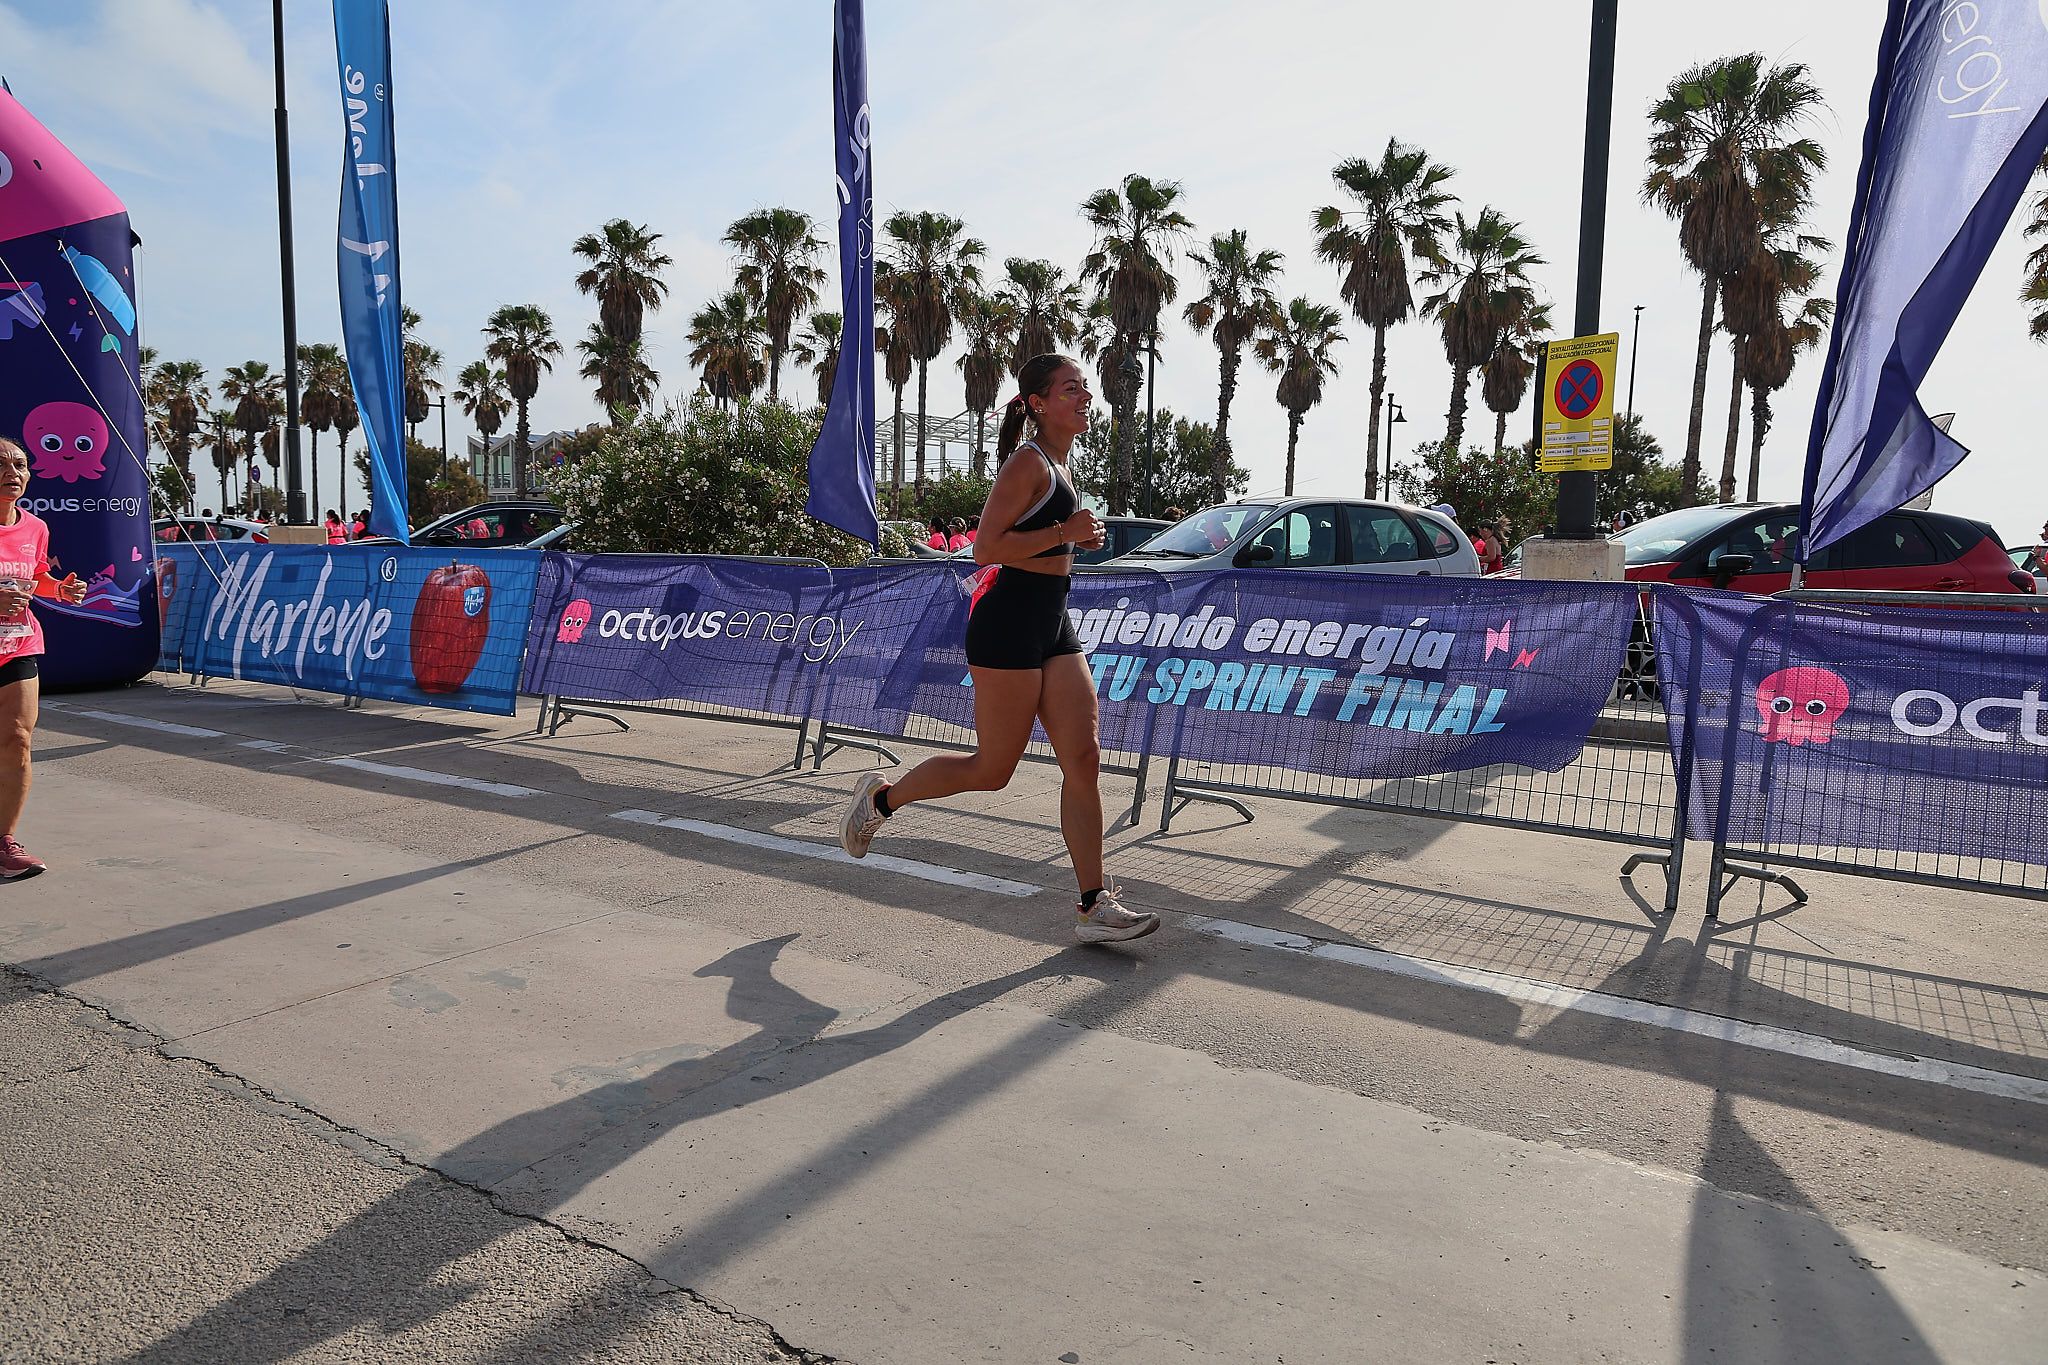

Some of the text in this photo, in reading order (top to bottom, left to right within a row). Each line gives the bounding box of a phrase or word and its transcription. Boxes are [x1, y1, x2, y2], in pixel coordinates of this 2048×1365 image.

[1937, 0, 2020, 118] ergy
[16, 497, 142, 516] opus energy
[204, 550, 392, 682] Marlene
[599, 606, 865, 665] octopus energy
[1066, 597, 1456, 676] giendo energía
[1089, 653, 1508, 736] TU SPRINT FINAL
